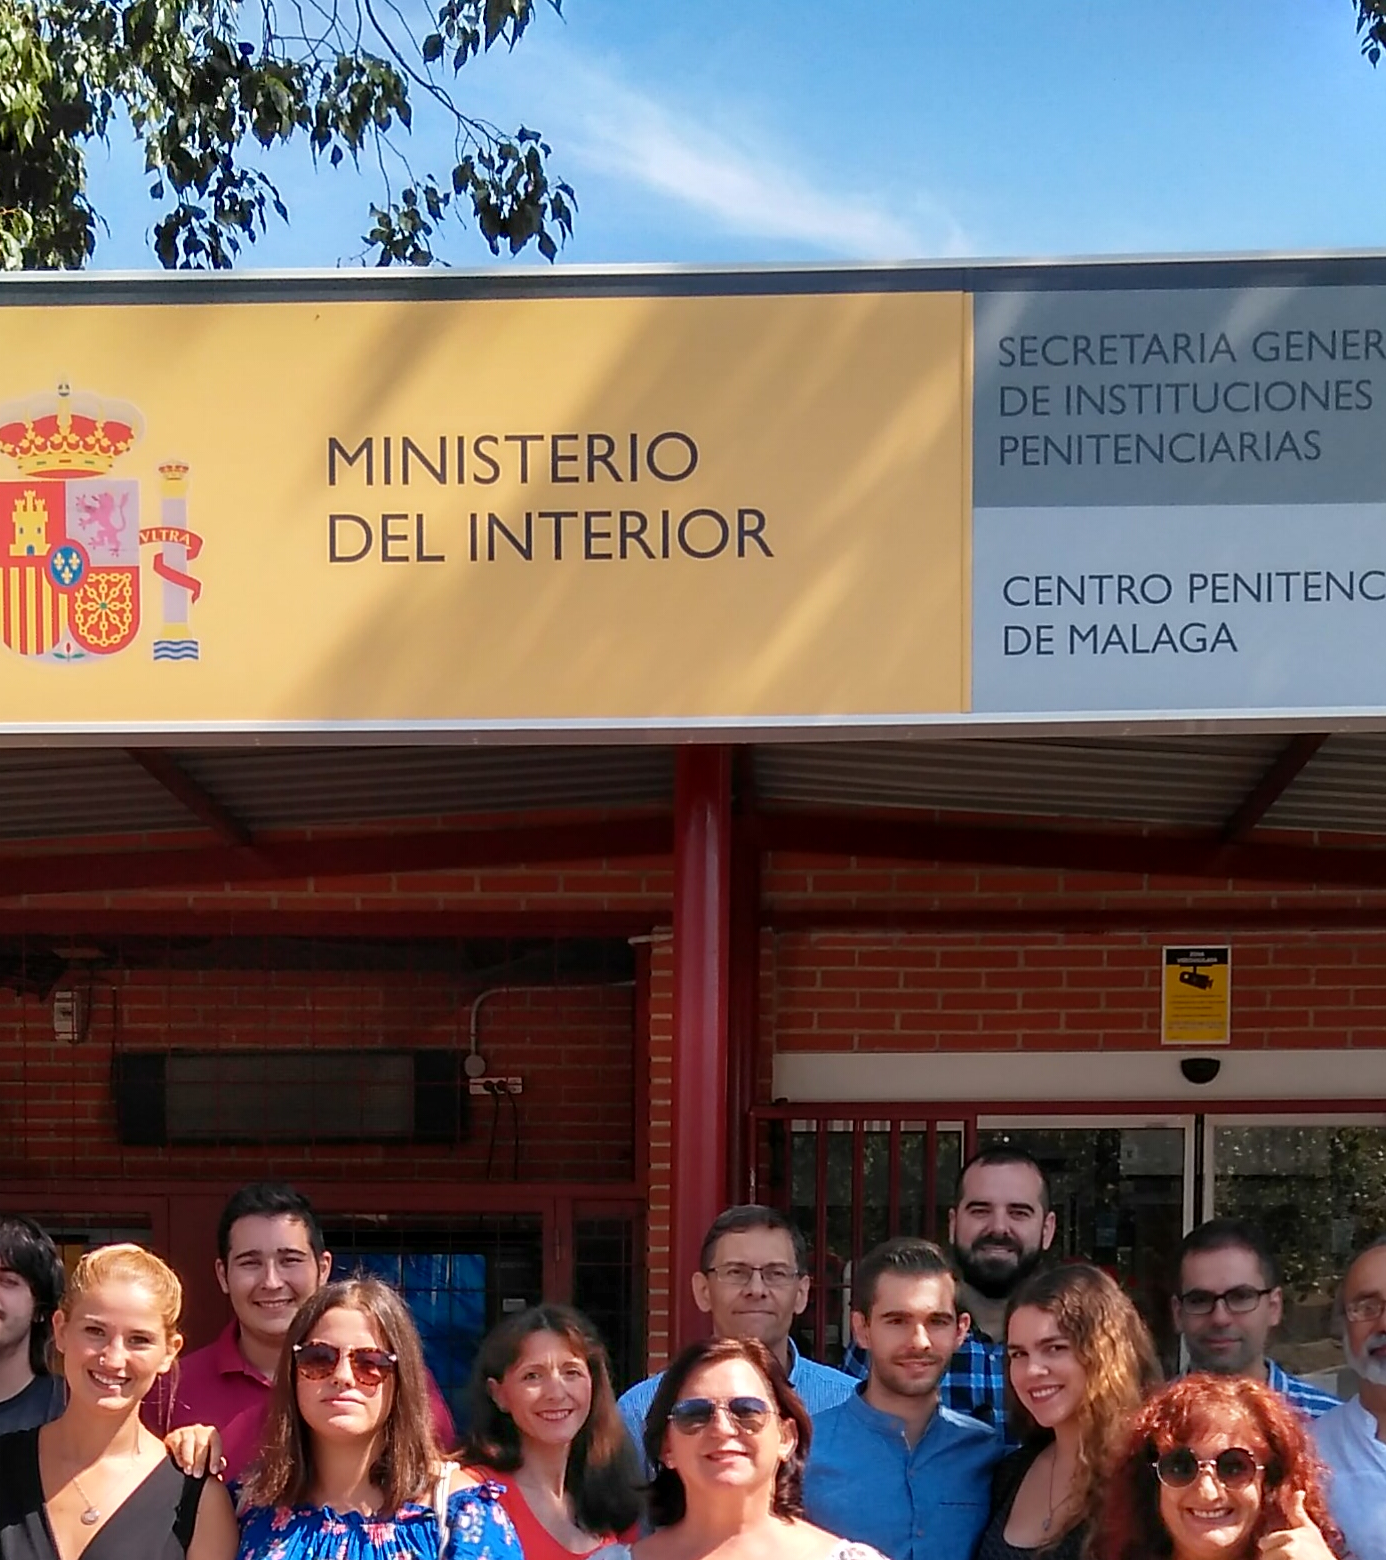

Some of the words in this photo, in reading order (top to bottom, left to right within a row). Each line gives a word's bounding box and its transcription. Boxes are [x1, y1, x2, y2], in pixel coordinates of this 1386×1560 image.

[999, 332, 1236, 367] SECRETARIA
[999, 385, 1050, 417] DE
[1066, 379, 1372, 415] INSTITUCIONES
[328, 432, 698, 486] MINISTERIO
[999, 430, 1321, 466] PENITENCIARIAS
[329, 512, 445, 563] DEL
[470, 508, 774, 561] INTERIOR
[1003, 573, 1172, 607] CENTRO
[1004, 625, 1054, 655] DE
[1070, 622, 1238, 654] MALAGA
